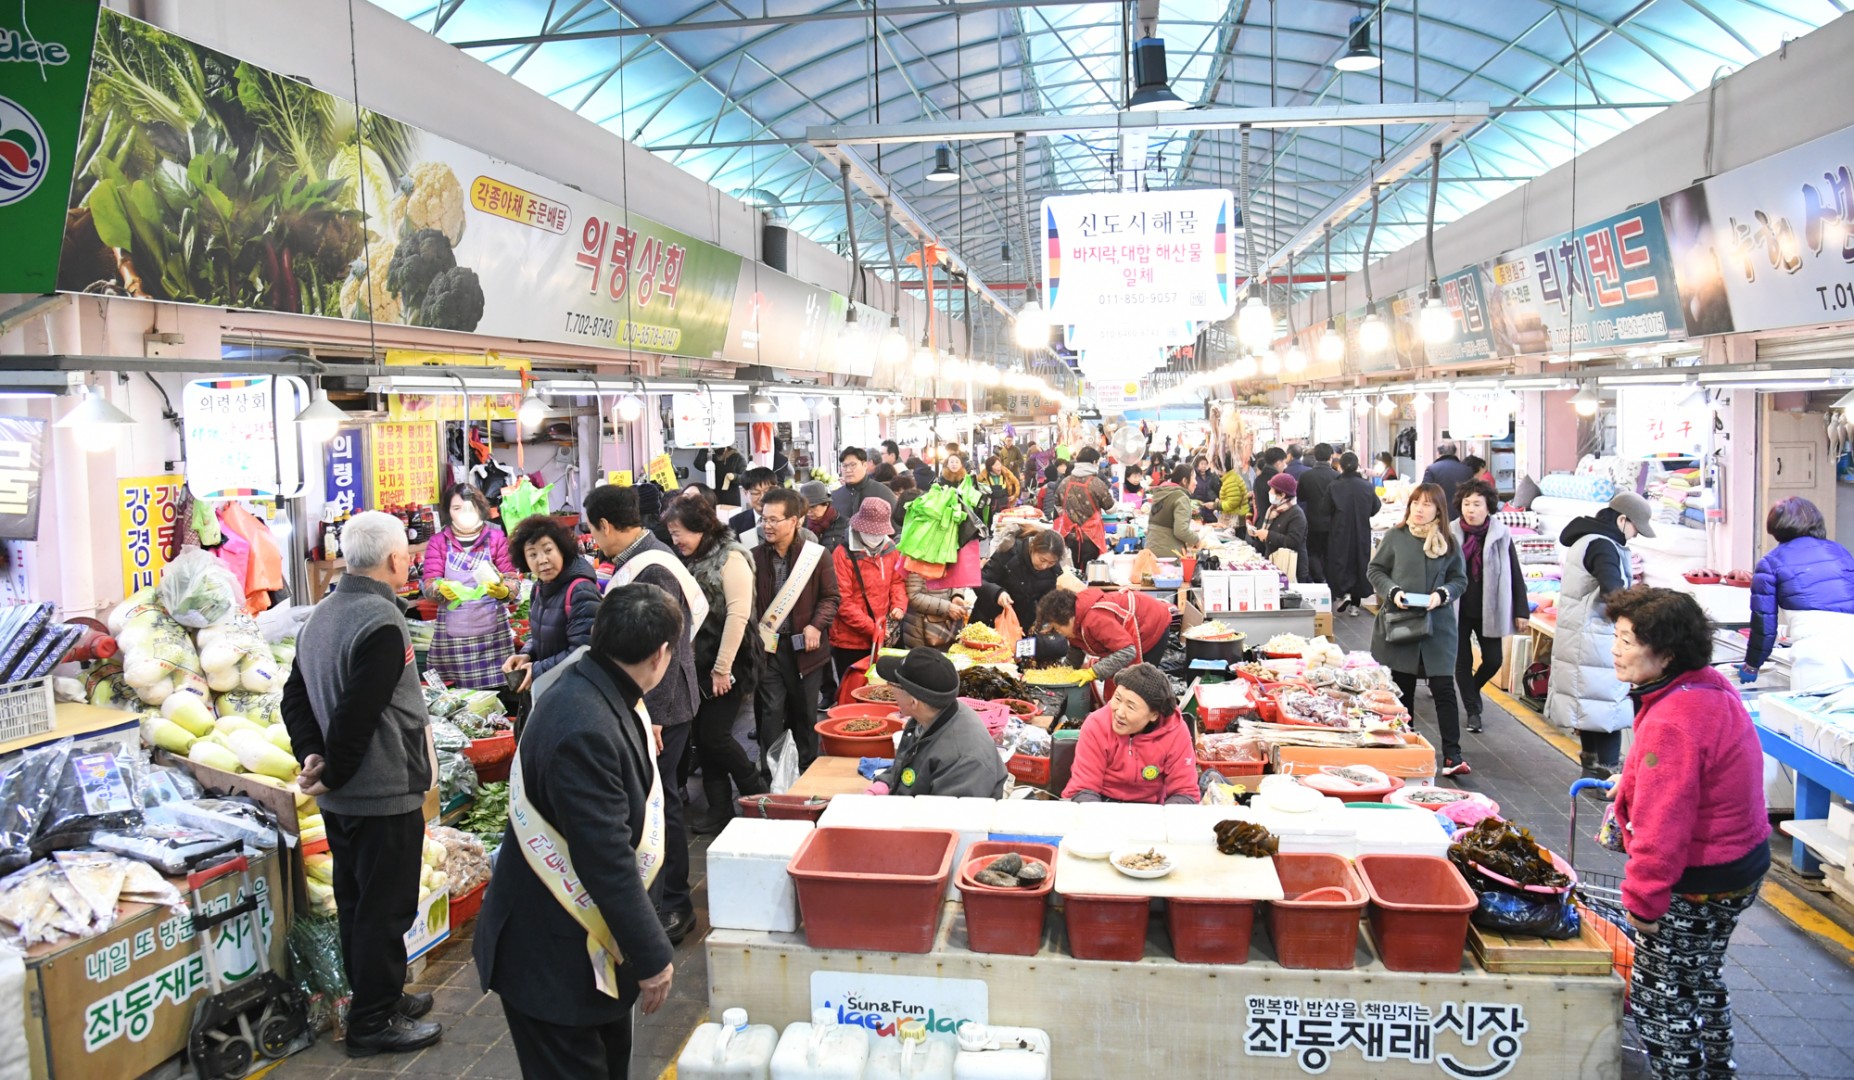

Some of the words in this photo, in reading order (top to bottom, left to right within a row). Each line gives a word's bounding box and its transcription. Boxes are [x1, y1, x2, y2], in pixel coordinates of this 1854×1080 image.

[477, 181, 524, 217] 각종야채
[526, 198, 567, 231] 주문배달
[1078, 210, 1199, 238] 신도시해물
[576, 216, 686, 309] 의령상회
[1073, 244, 1150, 265] 바지락,대합
[1155, 243, 1203, 263] 해산물
[1534, 216, 1660, 315] 리치랜드
[1122, 267, 1154, 287] 일체
[1098, 292, 1178, 305] 011-850-9057
[200, 392, 265, 414] 의령상회
[88, 942, 127, 979] 내일
[136, 931, 154, 957] 또
[847, 997, 925, 1014] Sun&Fun
[1249, 998, 1300, 1016] 행복한
[1306, 1001, 1357, 1018] 밥상을
[1364, 1003, 1430, 1022] 책임지는
